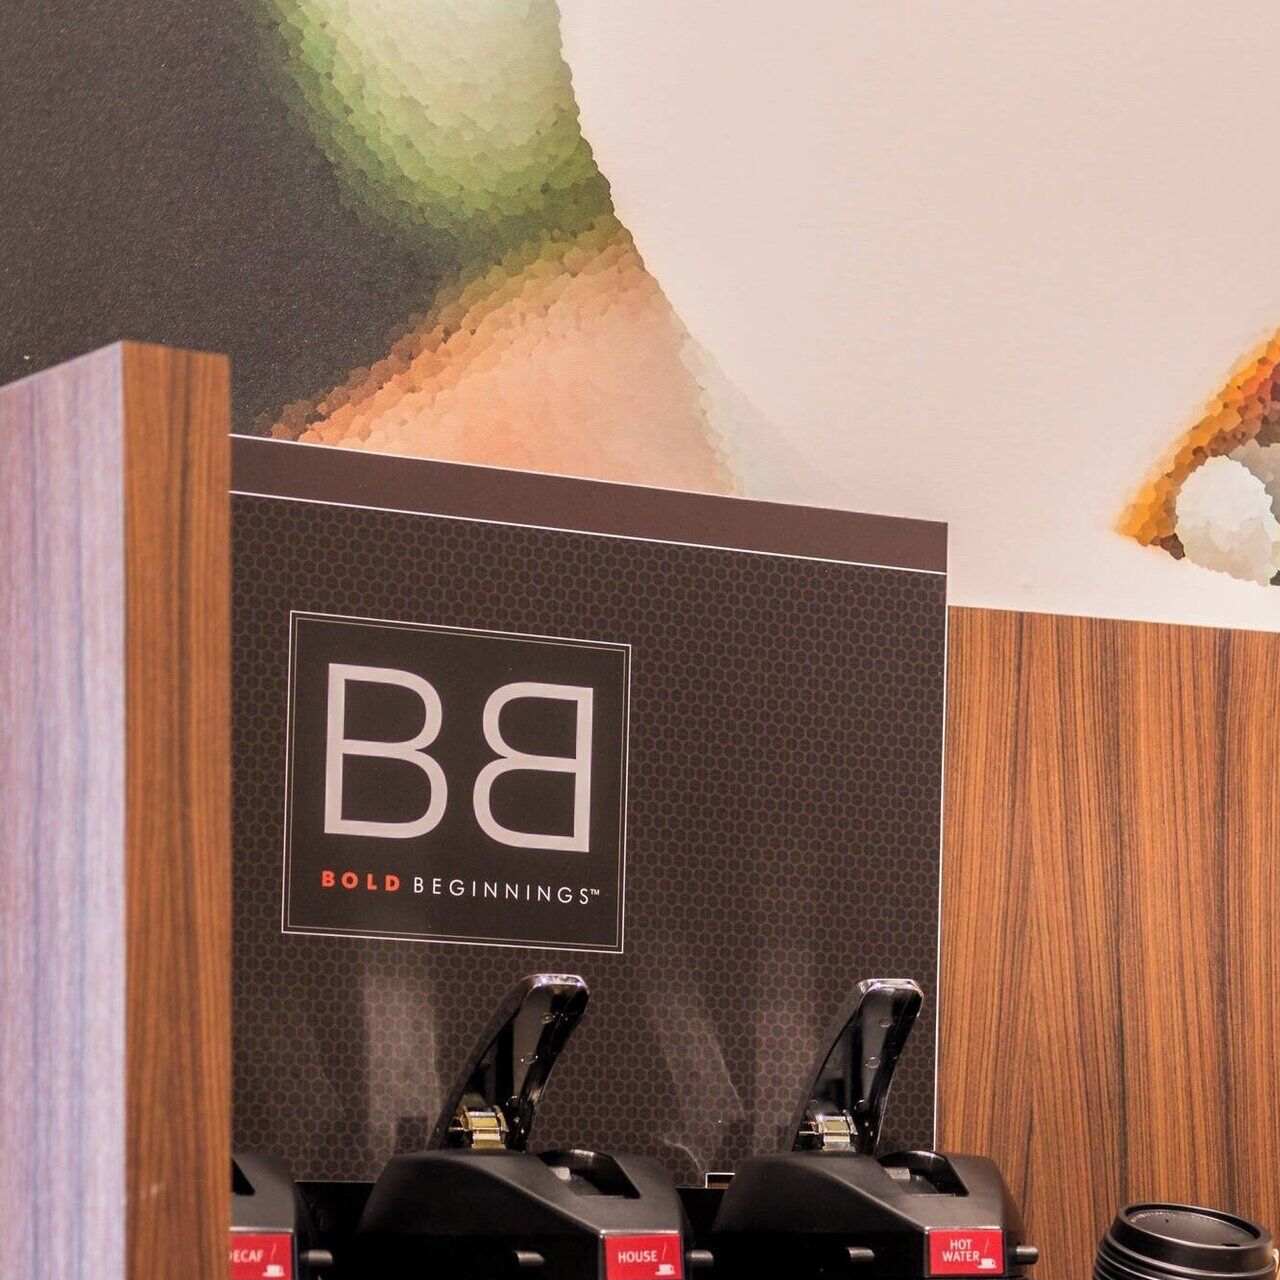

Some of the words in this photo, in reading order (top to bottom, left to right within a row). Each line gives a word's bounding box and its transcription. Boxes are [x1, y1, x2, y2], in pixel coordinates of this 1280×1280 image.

[321, 870, 400, 892] BOLD
[949, 1239, 973, 1250] HOT
[617, 1250, 659, 1263] HOUSE
[942, 1250, 980, 1262] WATER
